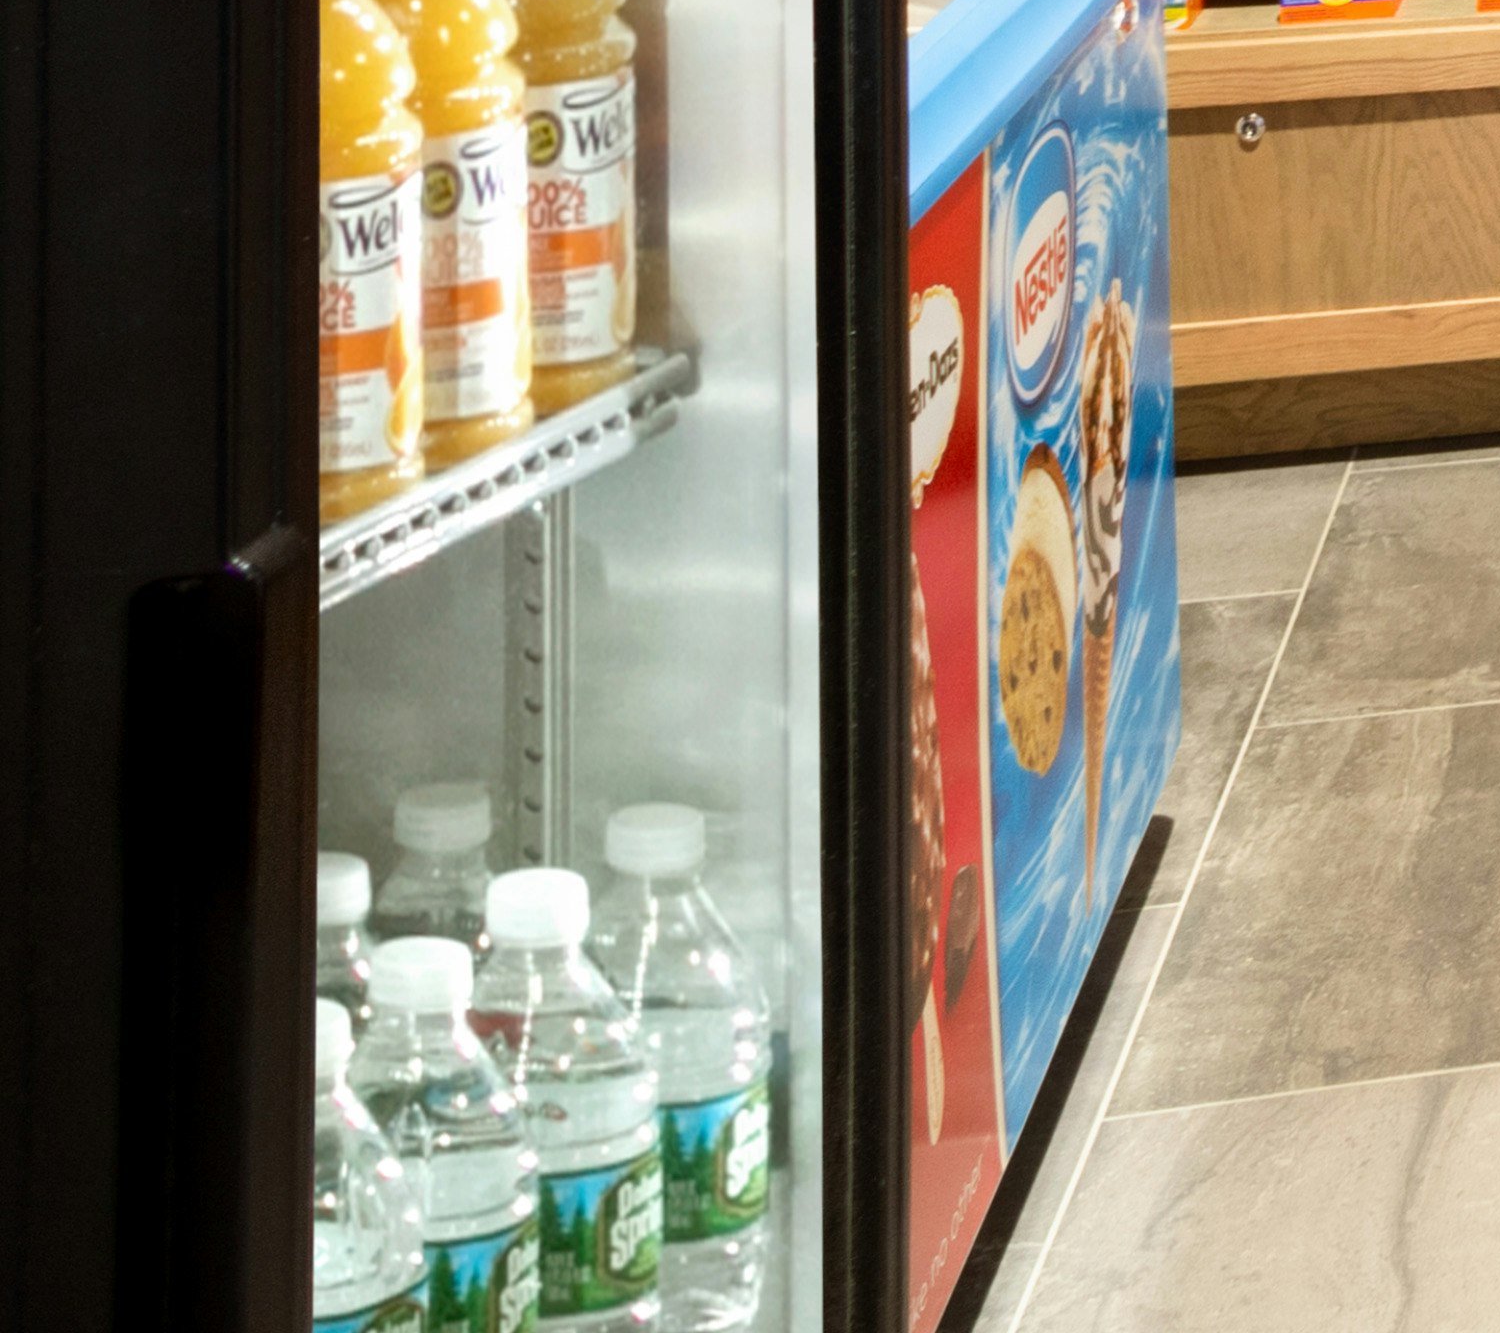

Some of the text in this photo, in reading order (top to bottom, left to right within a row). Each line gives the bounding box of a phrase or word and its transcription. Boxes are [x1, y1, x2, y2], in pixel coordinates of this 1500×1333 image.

[571, 87, 635, 161] Welc
[1015, 215, 1069, 347] Nestlé
[909, 336, 959, 424] en-Dazs
